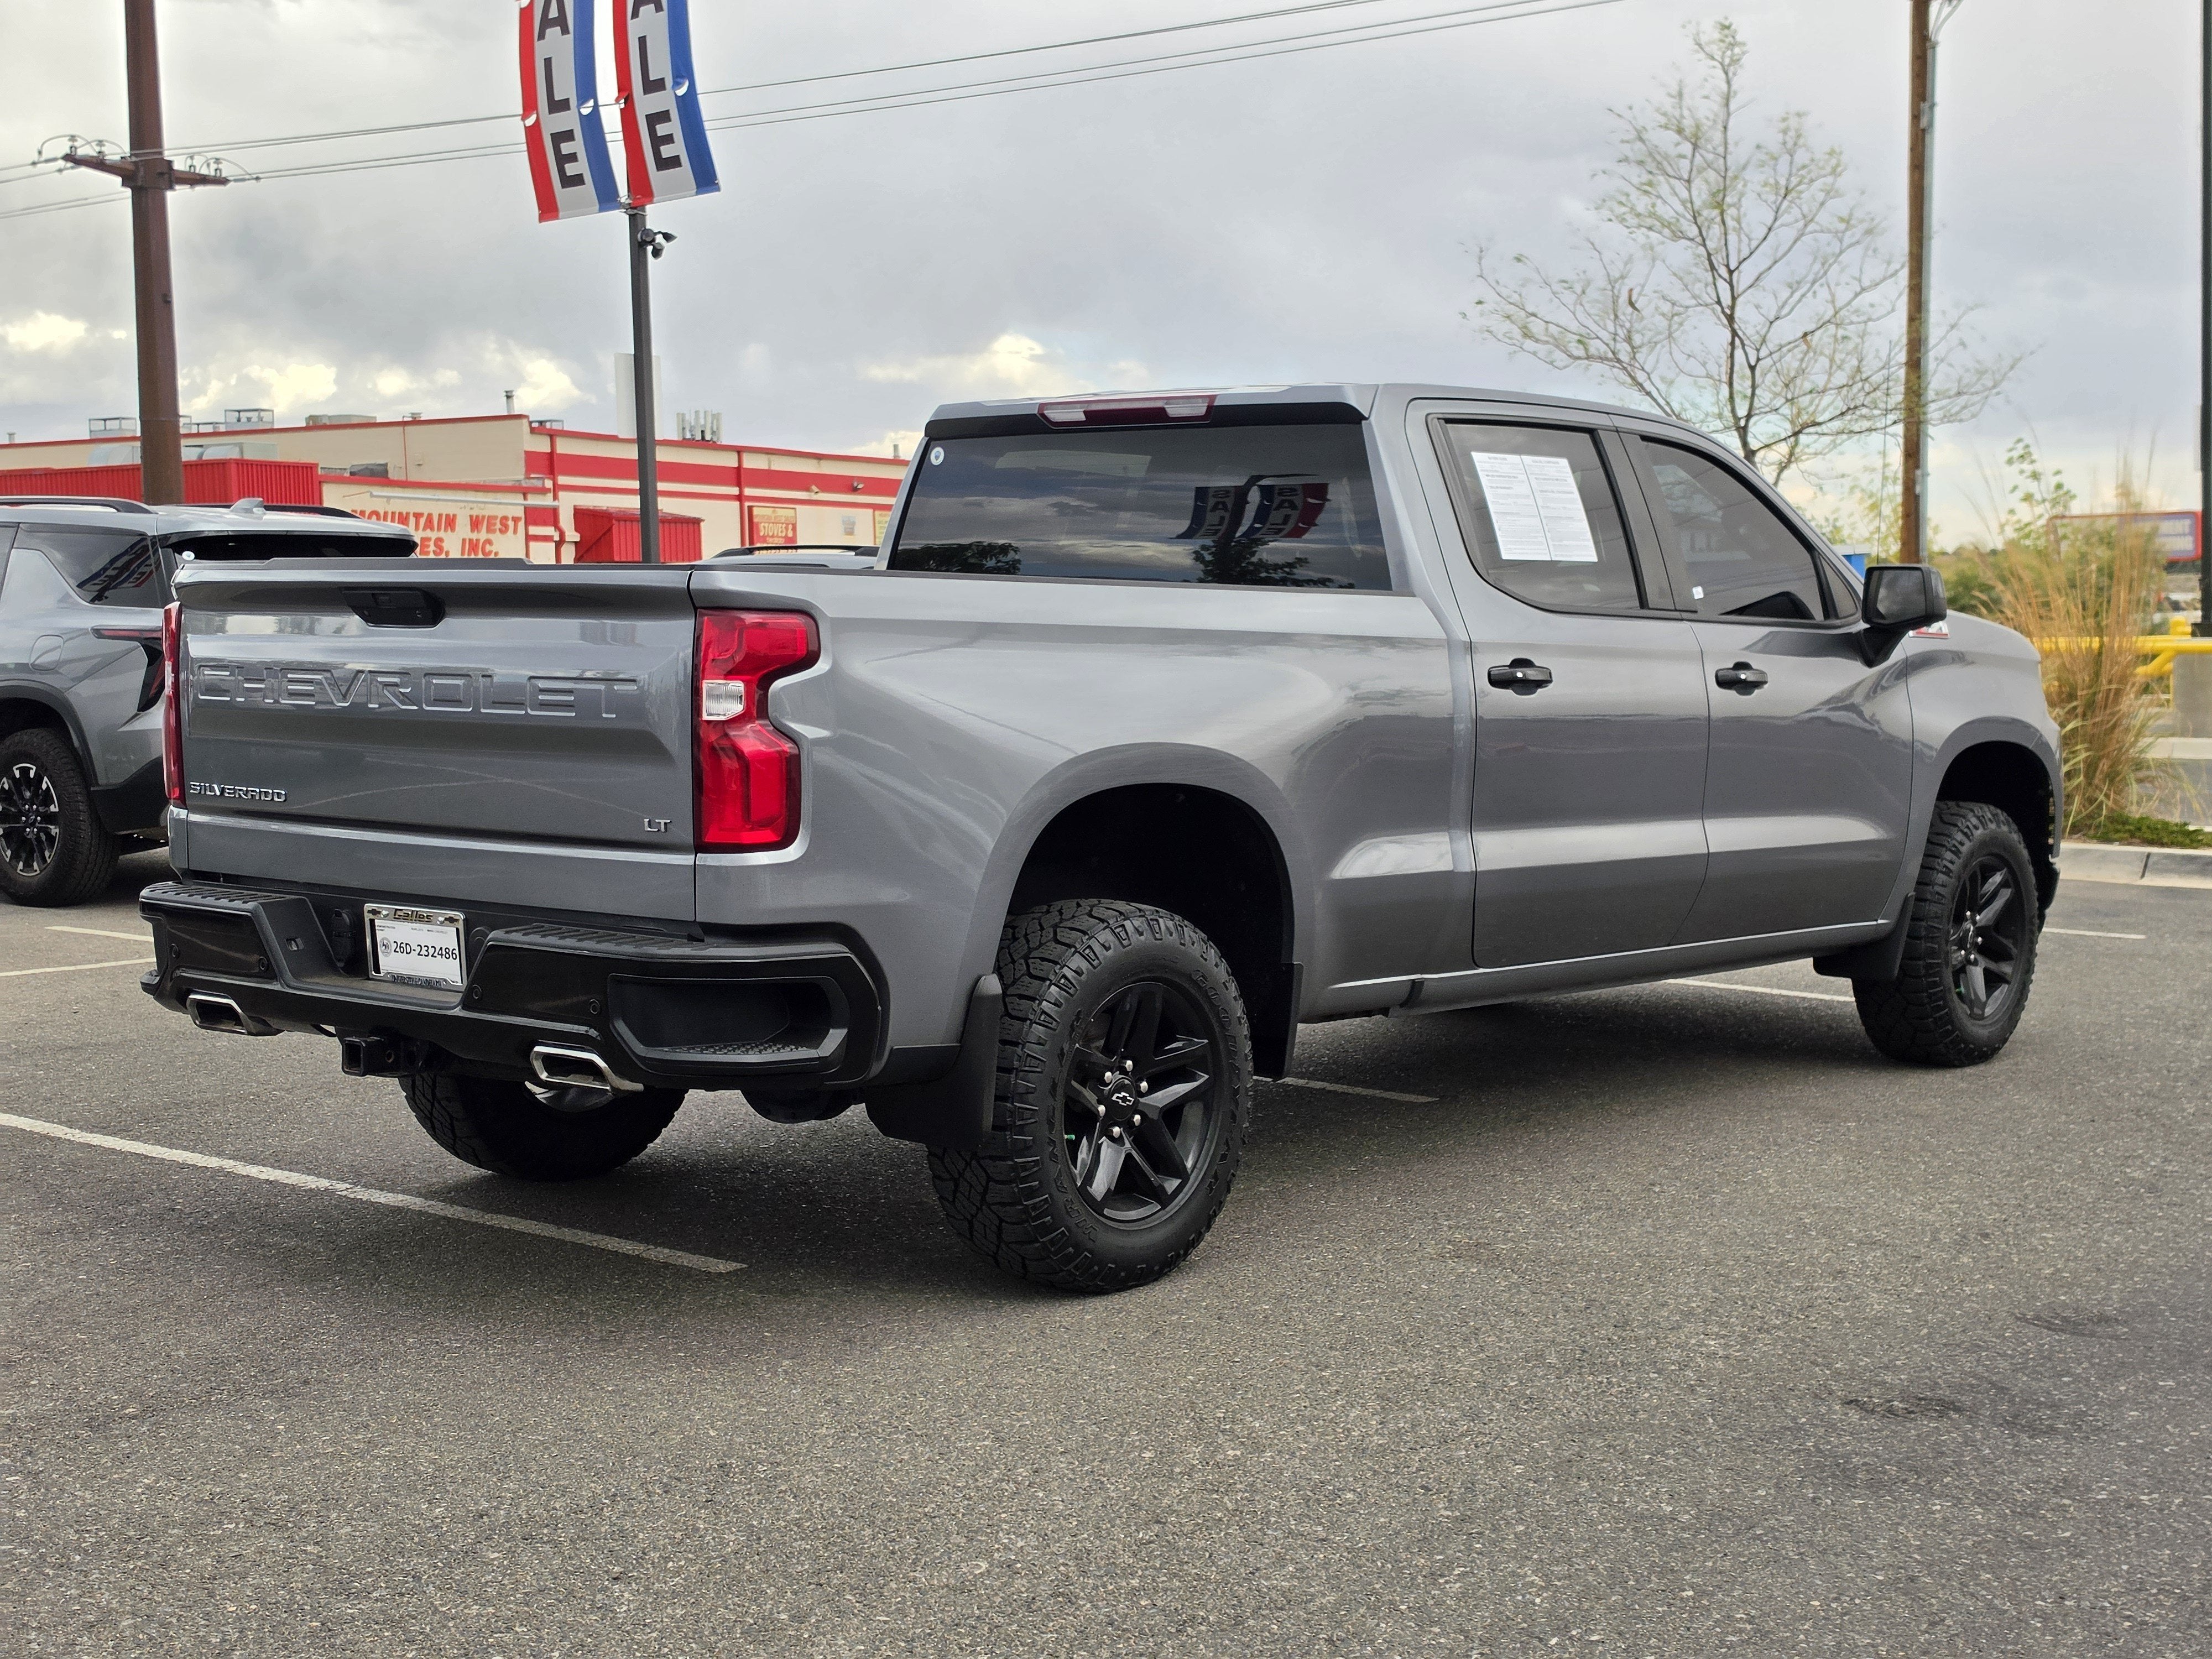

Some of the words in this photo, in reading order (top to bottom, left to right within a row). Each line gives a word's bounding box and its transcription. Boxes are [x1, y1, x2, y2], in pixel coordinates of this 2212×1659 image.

[469, 514, 522, 535] WEST
[759, 523, 786, 536] STOVES
[787, 524, 793, 537] &
[461, 538, 499, 557] INC.
[197, 664, 638, 718] CHEVROLET
[189, 781, 286, 802] SILVERADO
[644, 818, 671, 832] LT
[393, 941, 458, 961] 26D-232486
